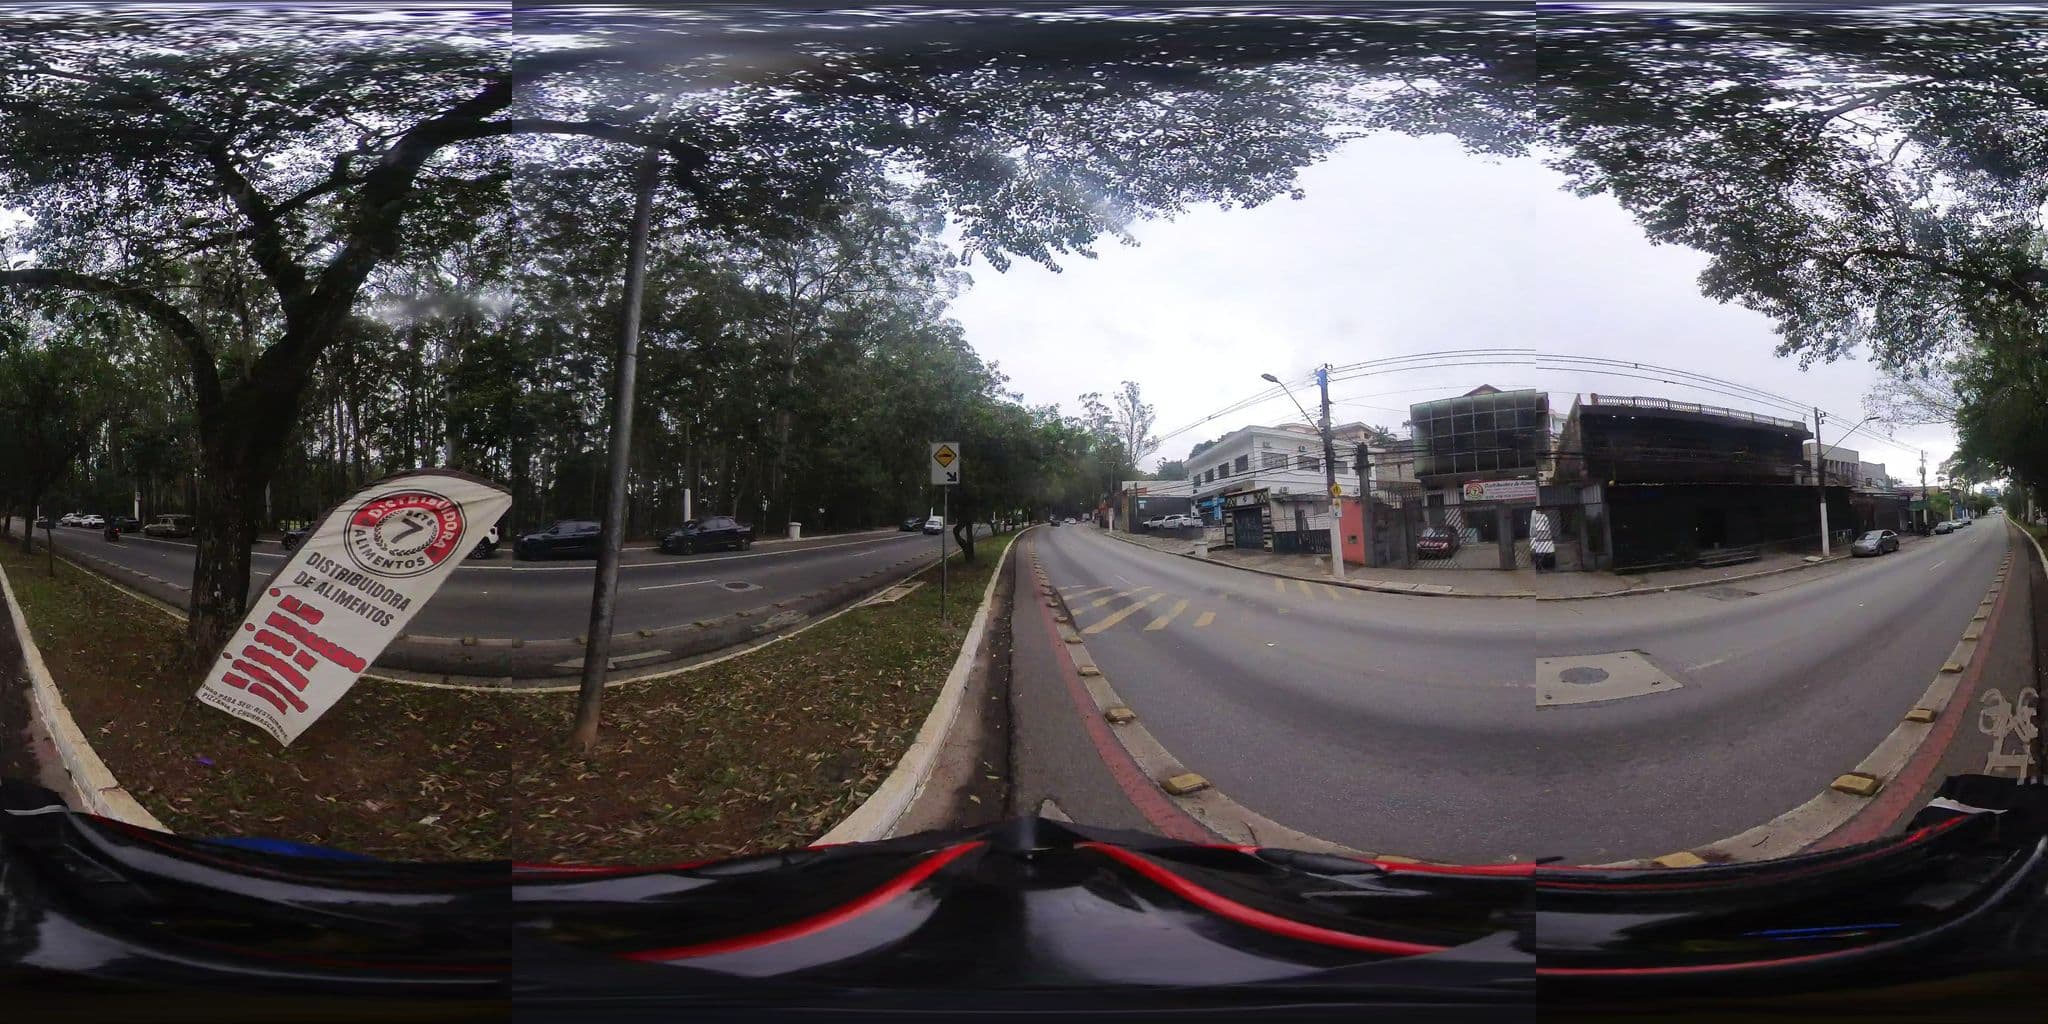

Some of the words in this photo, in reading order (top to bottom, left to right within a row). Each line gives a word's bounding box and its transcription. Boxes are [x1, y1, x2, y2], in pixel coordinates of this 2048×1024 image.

[354, 529, 425, 569] ALIMENTOS
[390, 518, 424, 544] 7
[293, 570, 316, 588] DE
[314, 581, 394, 627] ALIMENTOS
[305, 552, 411, 611] DISTRIBUIDORA
